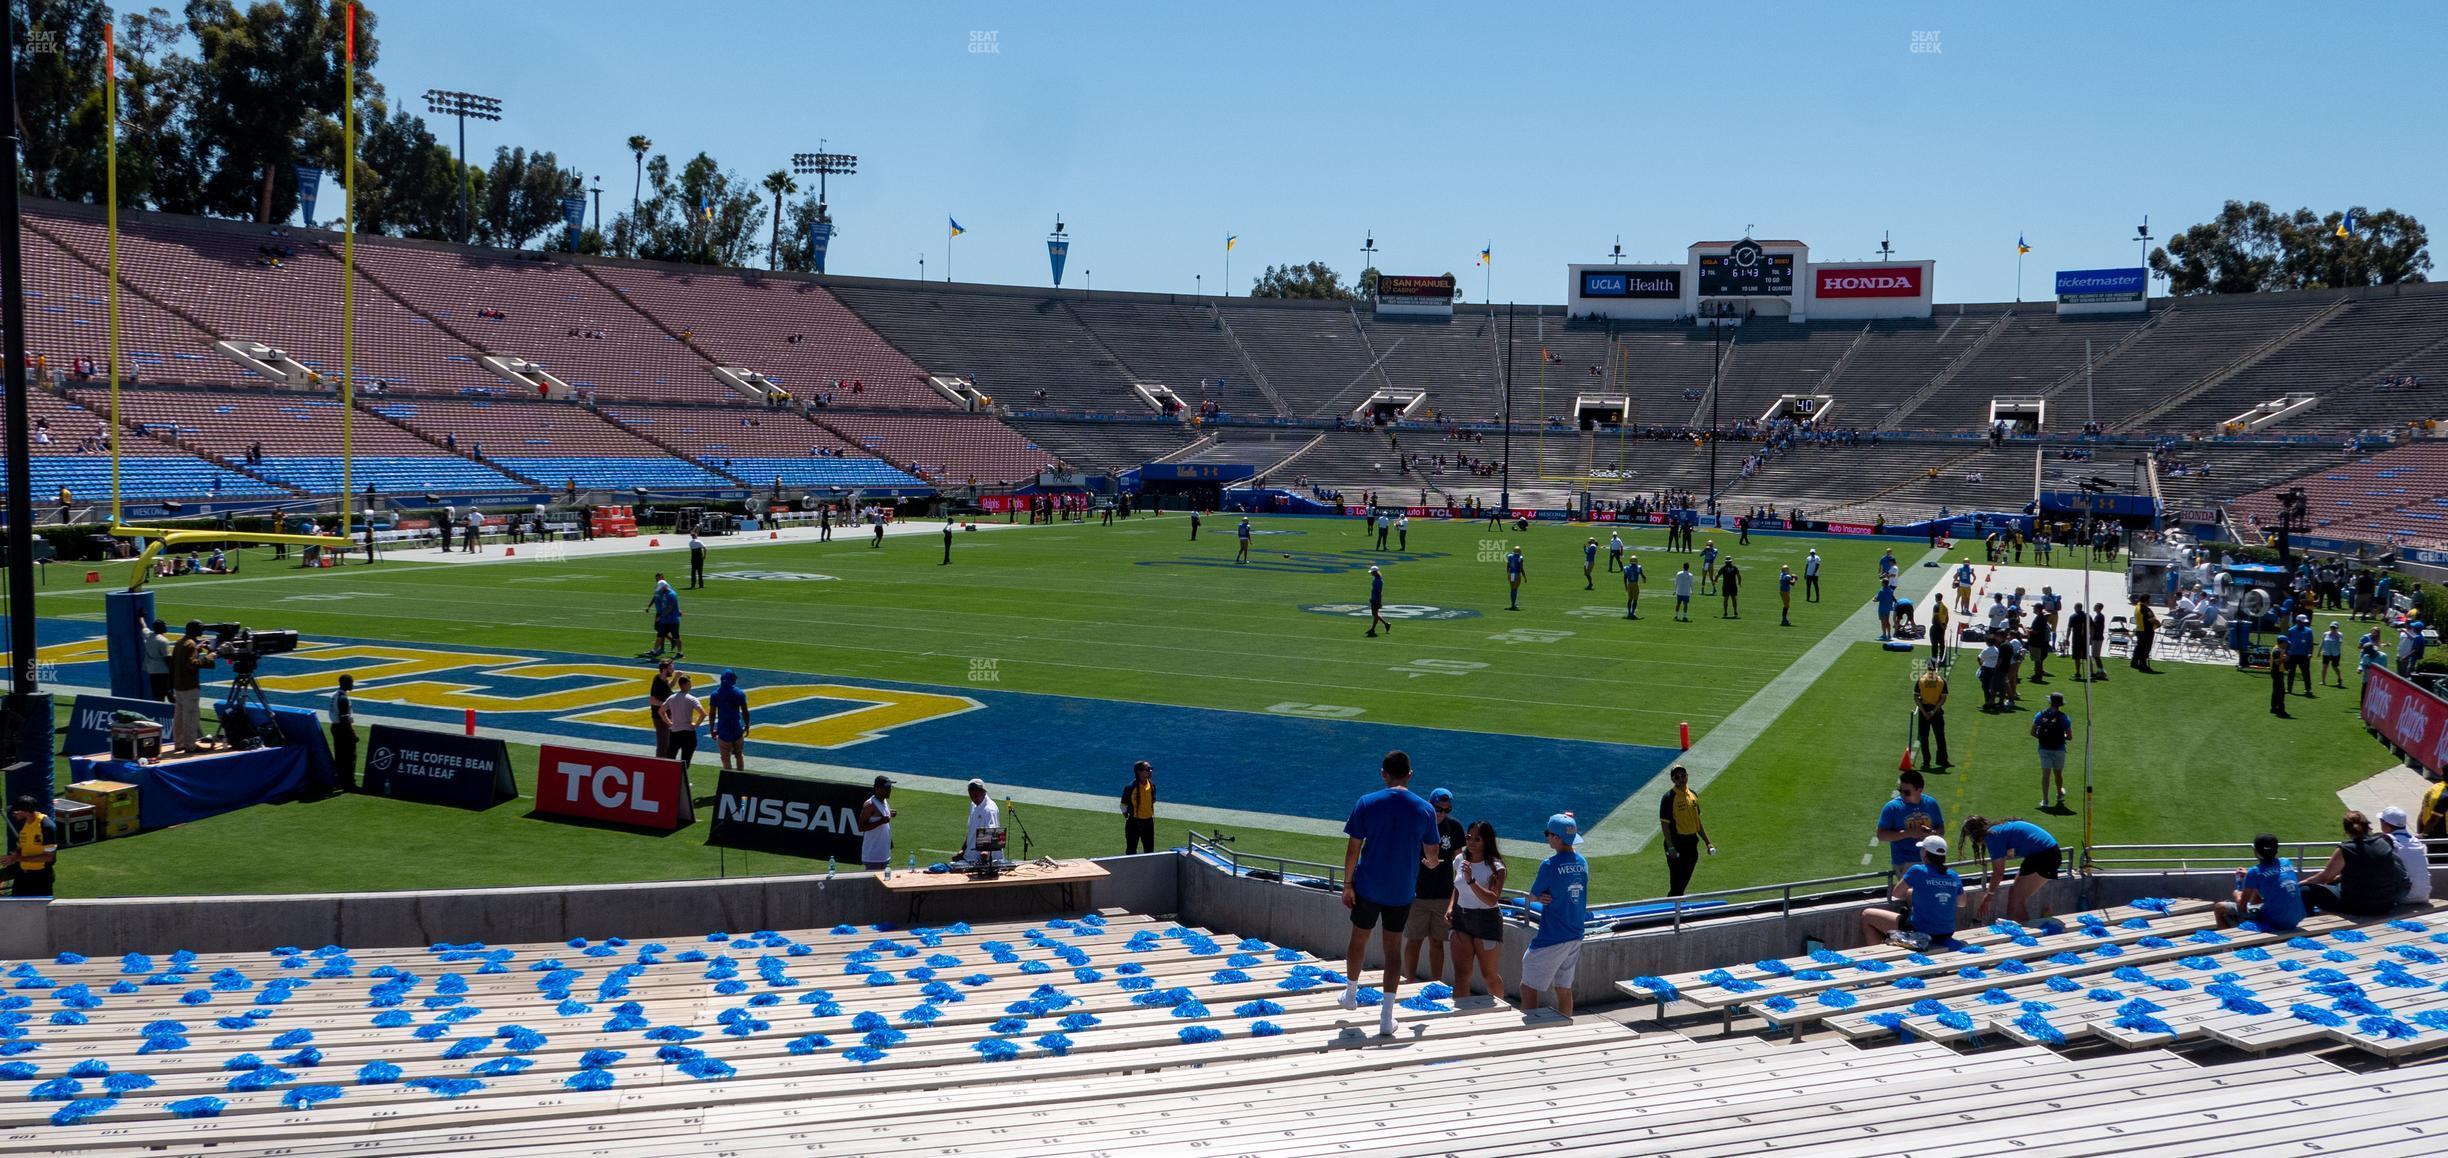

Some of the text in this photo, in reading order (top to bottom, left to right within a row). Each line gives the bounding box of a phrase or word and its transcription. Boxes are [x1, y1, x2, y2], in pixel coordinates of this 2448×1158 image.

[1723, 258, 1729, 266] 0
[1701, 269, 1706, 277] 3
[1787, 268, 1791, 276] 3
[1393, 280, 1453, 289] SAN MANUEL
[1592, 278, 1674, 291] UCLA Health
[1823, 276, 1913, 290] HONDA
[2058, 276, 2137, 287] ticketmaster
[1796, 400, 1812, 412] 40
[1429, 509, 1452, 517] TCL
[2181, 510, 2214, 521] HONDA
[1827, 522, 1871, 535] Auto Insurance
[2364, 675, 2391, 724] Ralphs
[2395, 695, 2429, 746] Ralphs
[400, 750, 494, 771] THE COFFEE BEAN
[406, 764, 426, 776] TEA
[428, 767, 456, 779] LEAF
[557, 761, 660, 813] TCL
[718, 793, 864, 836] NISSAN
